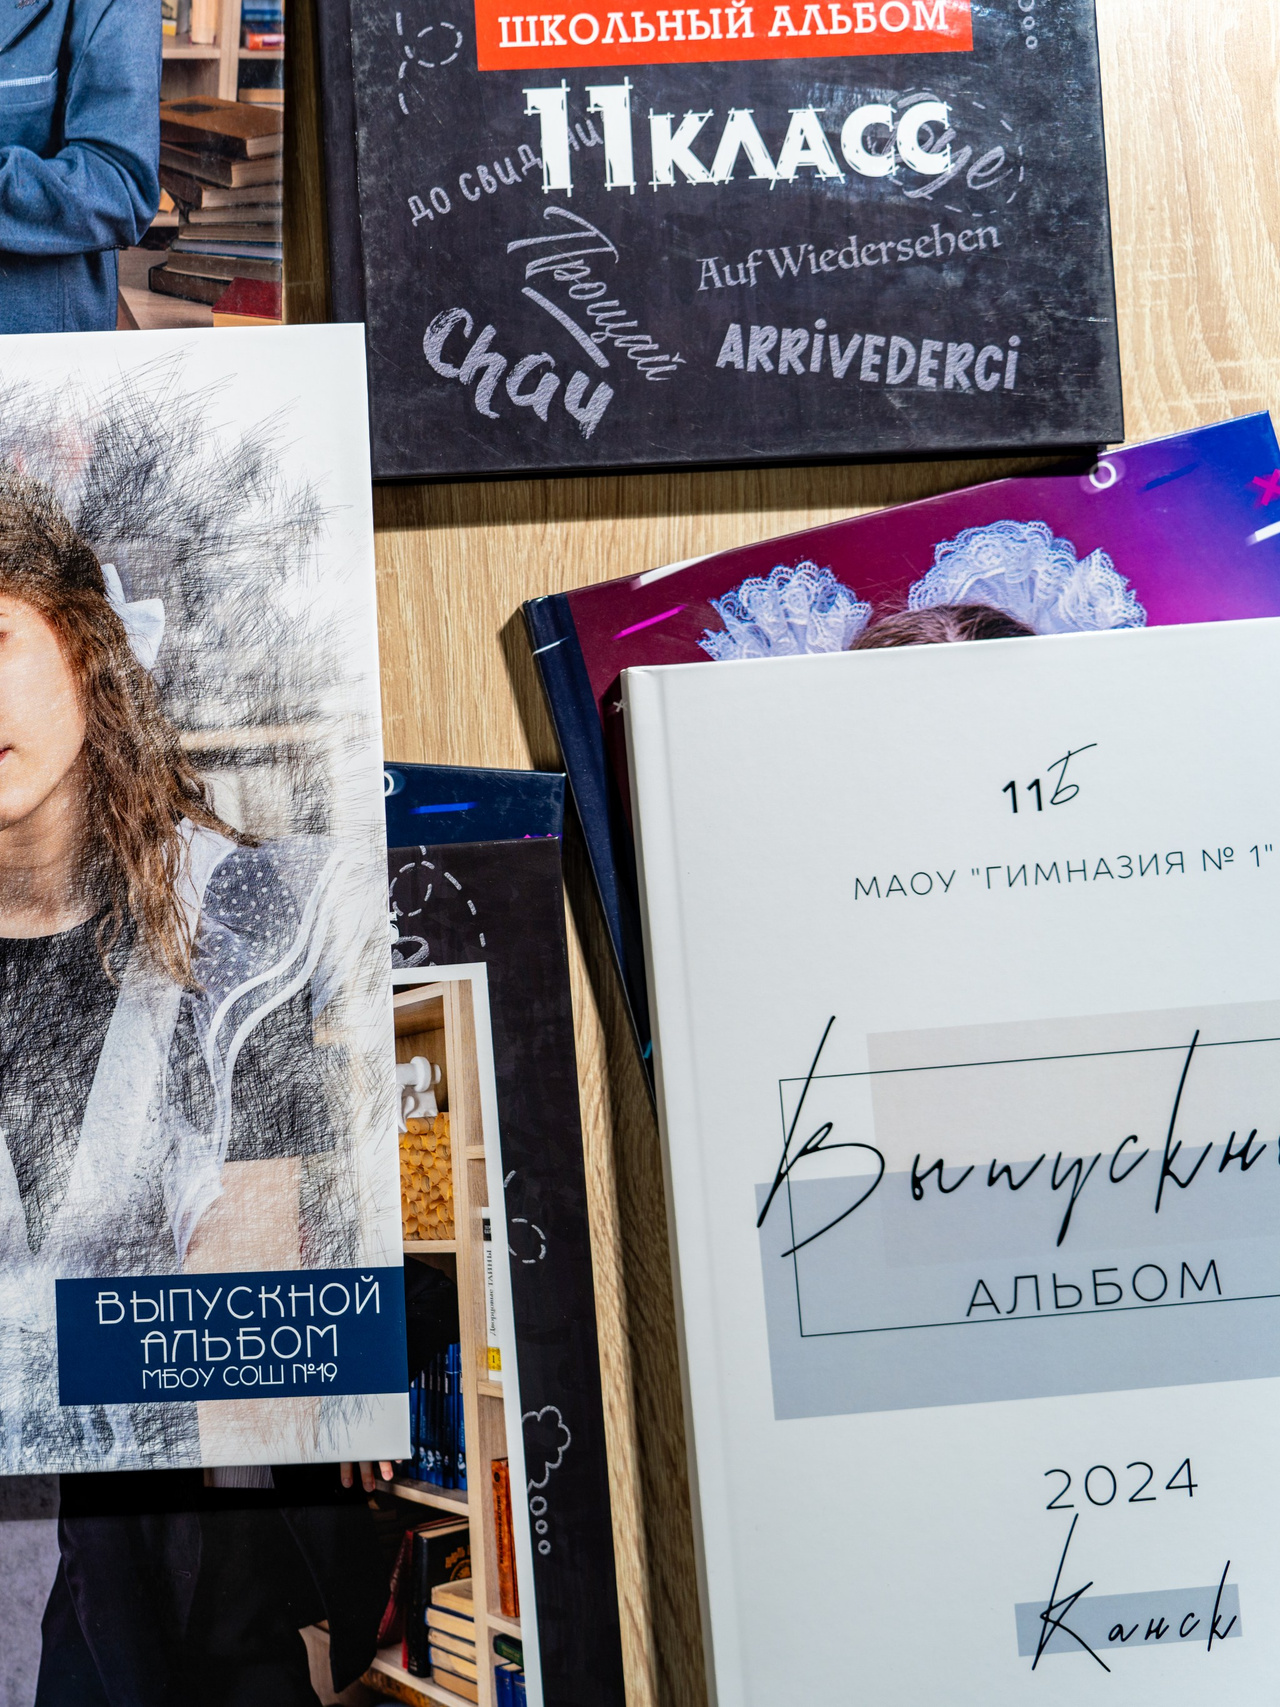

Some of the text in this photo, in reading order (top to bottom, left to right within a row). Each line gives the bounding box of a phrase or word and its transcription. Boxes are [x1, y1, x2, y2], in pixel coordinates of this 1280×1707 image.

[497, 0, 950, 48] ШКОЛЬНЫЙ АЛЬБОМ
[522, 76, 954, 197] 11 КЛАСС
[697, 222, 1002, 292] Auf Wiedersehen
[853, 868, 956, 901] МАОУ
[970, 850, 1186, 890] "ГИМНАЗИЯ
[95, 1274, 381, 1326] ВЫПУСКНОЙ
[965, 1258, 1223, 1318] АЛЬБОМ
[140, 1323, 339, 1365] АЛЬБОМ
[141, 1361, 339, 1390] МБОУ СОШ №19
[1043, 1457, 1199, 1511] 2024
[1031, 1512, 1238, 1673] Канск
